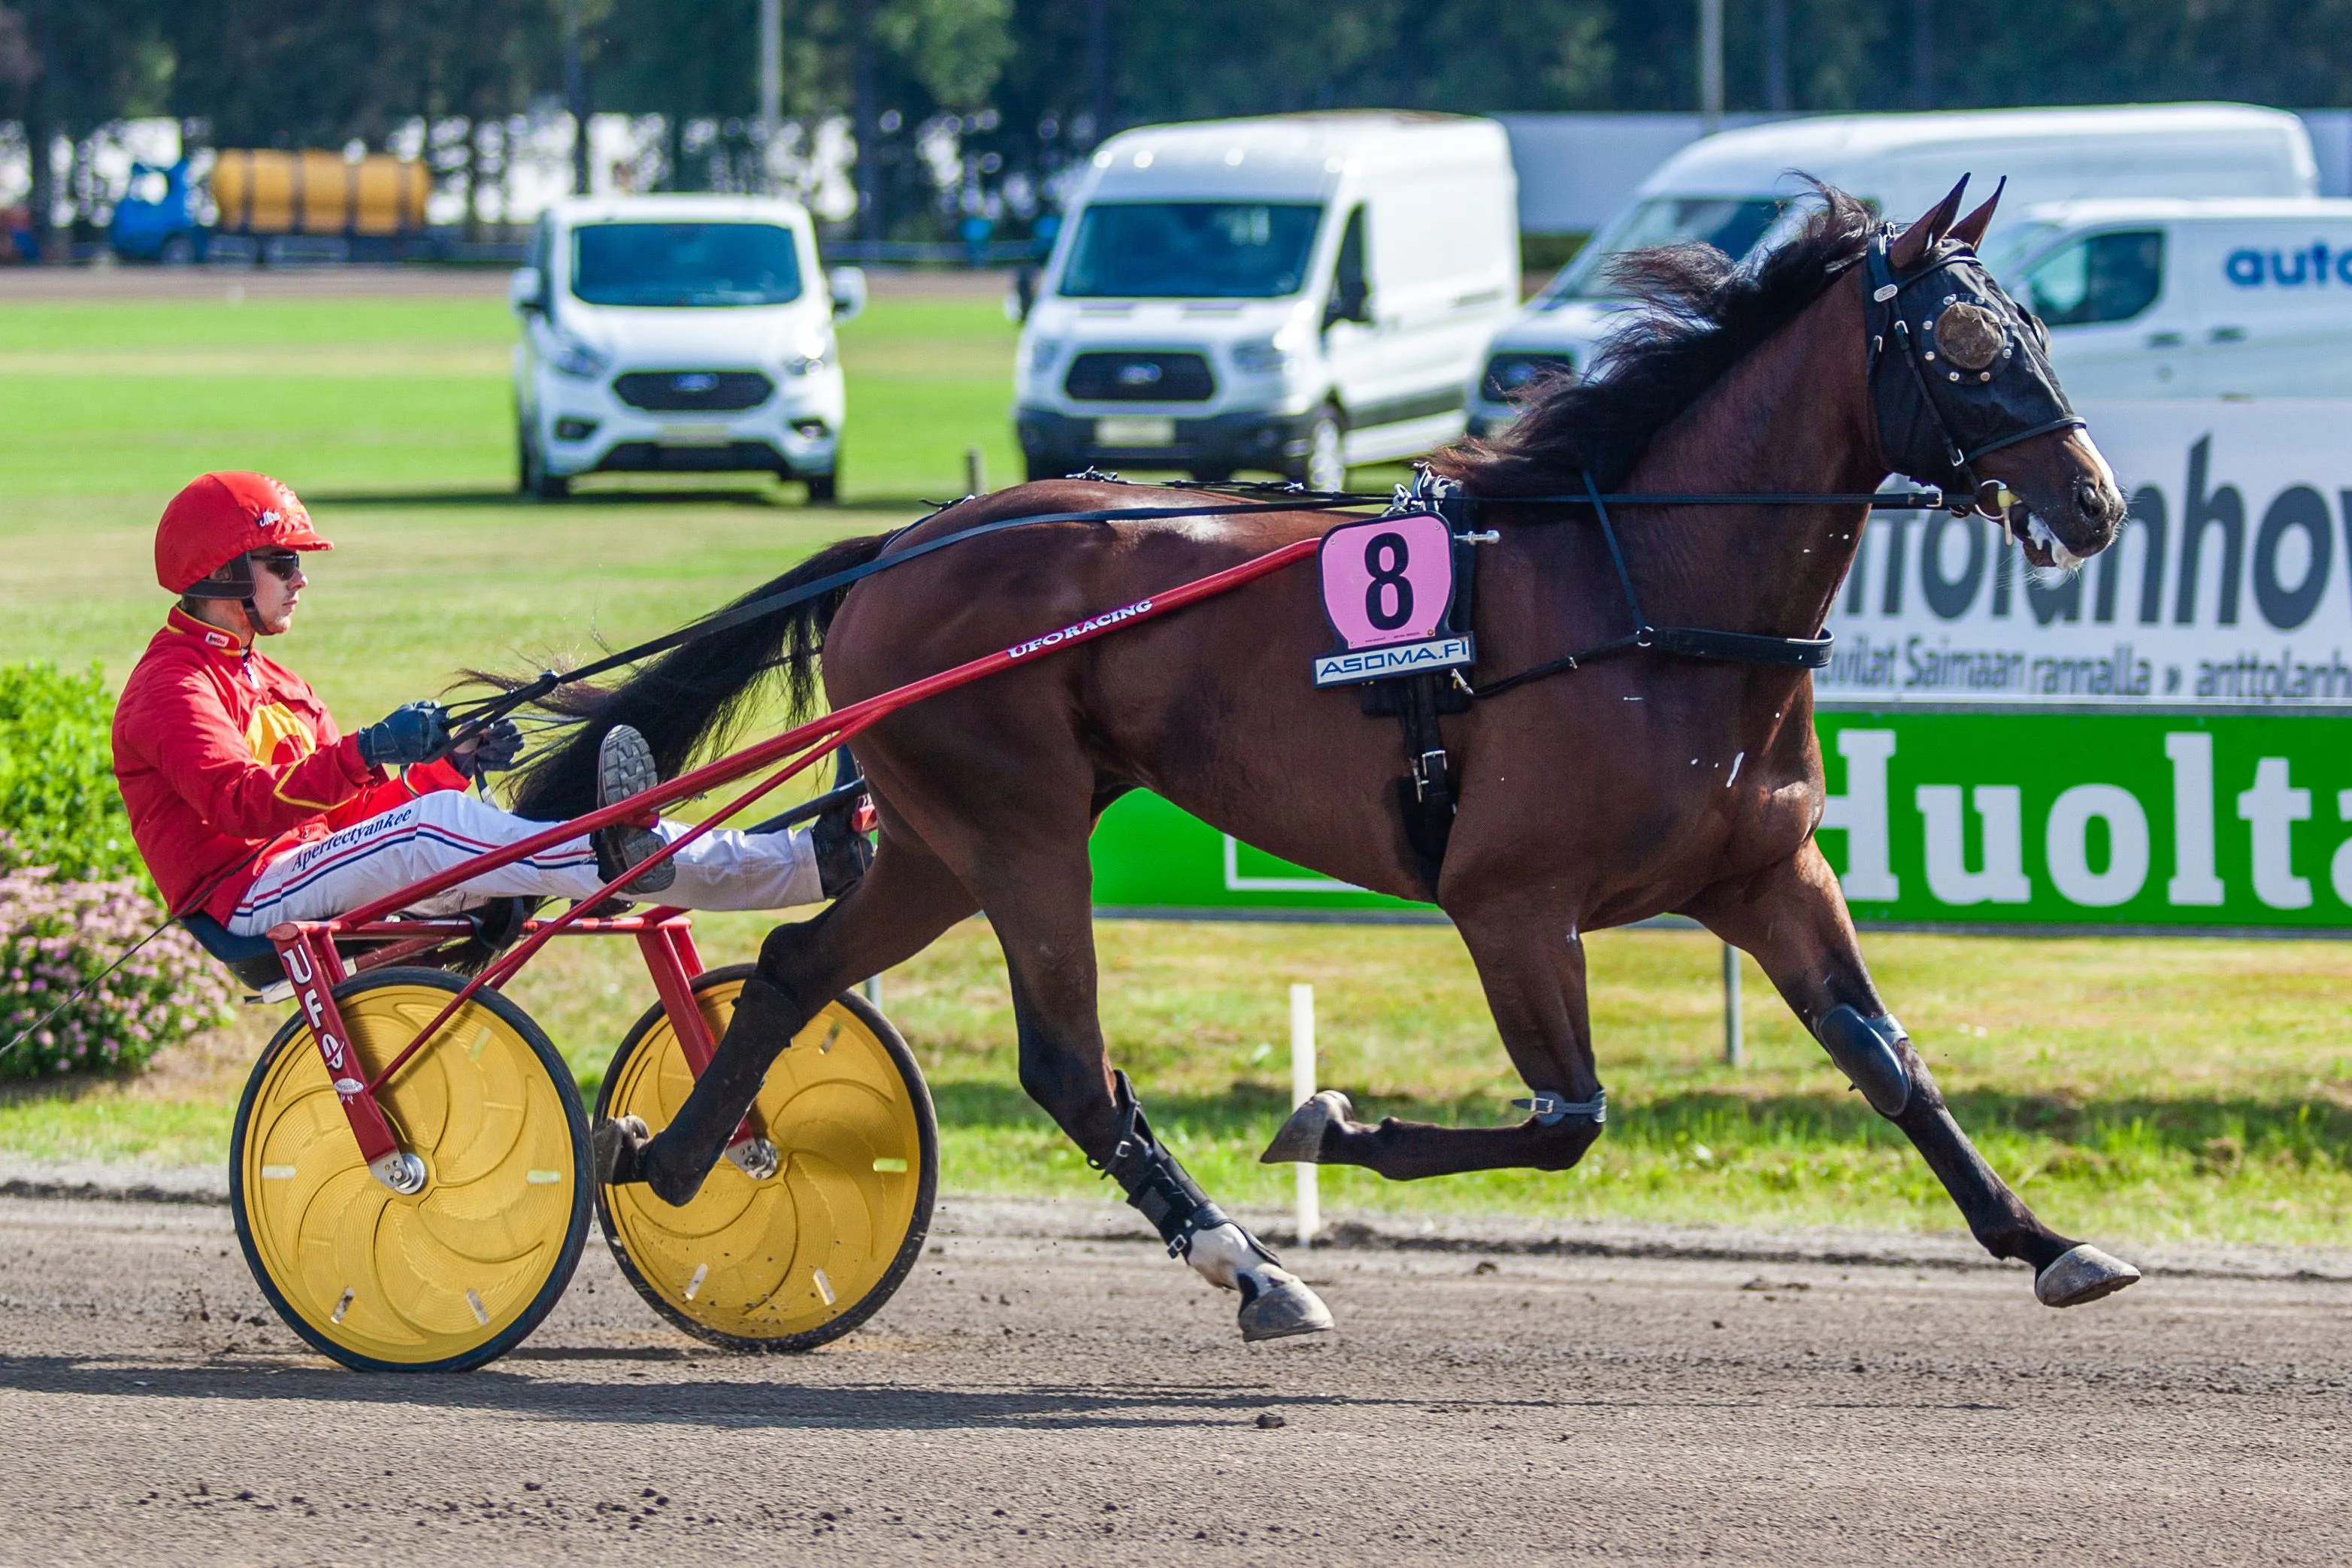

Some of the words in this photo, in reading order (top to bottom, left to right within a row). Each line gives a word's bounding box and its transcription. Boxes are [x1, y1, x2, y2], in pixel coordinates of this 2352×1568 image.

[1364, 532, 1414, 631] 8
[1007, 600, 1153, 658] UFORACING
[1321, 640, 1467, 677] ASOMA.FI
[1904, 633, 2025, 689] Saimaan
[2032, 643, 2151, 695] rannalla
[292, 809, 412, 872] Aperfectyankee
[1813, 728, 2352, 910] Huolt
